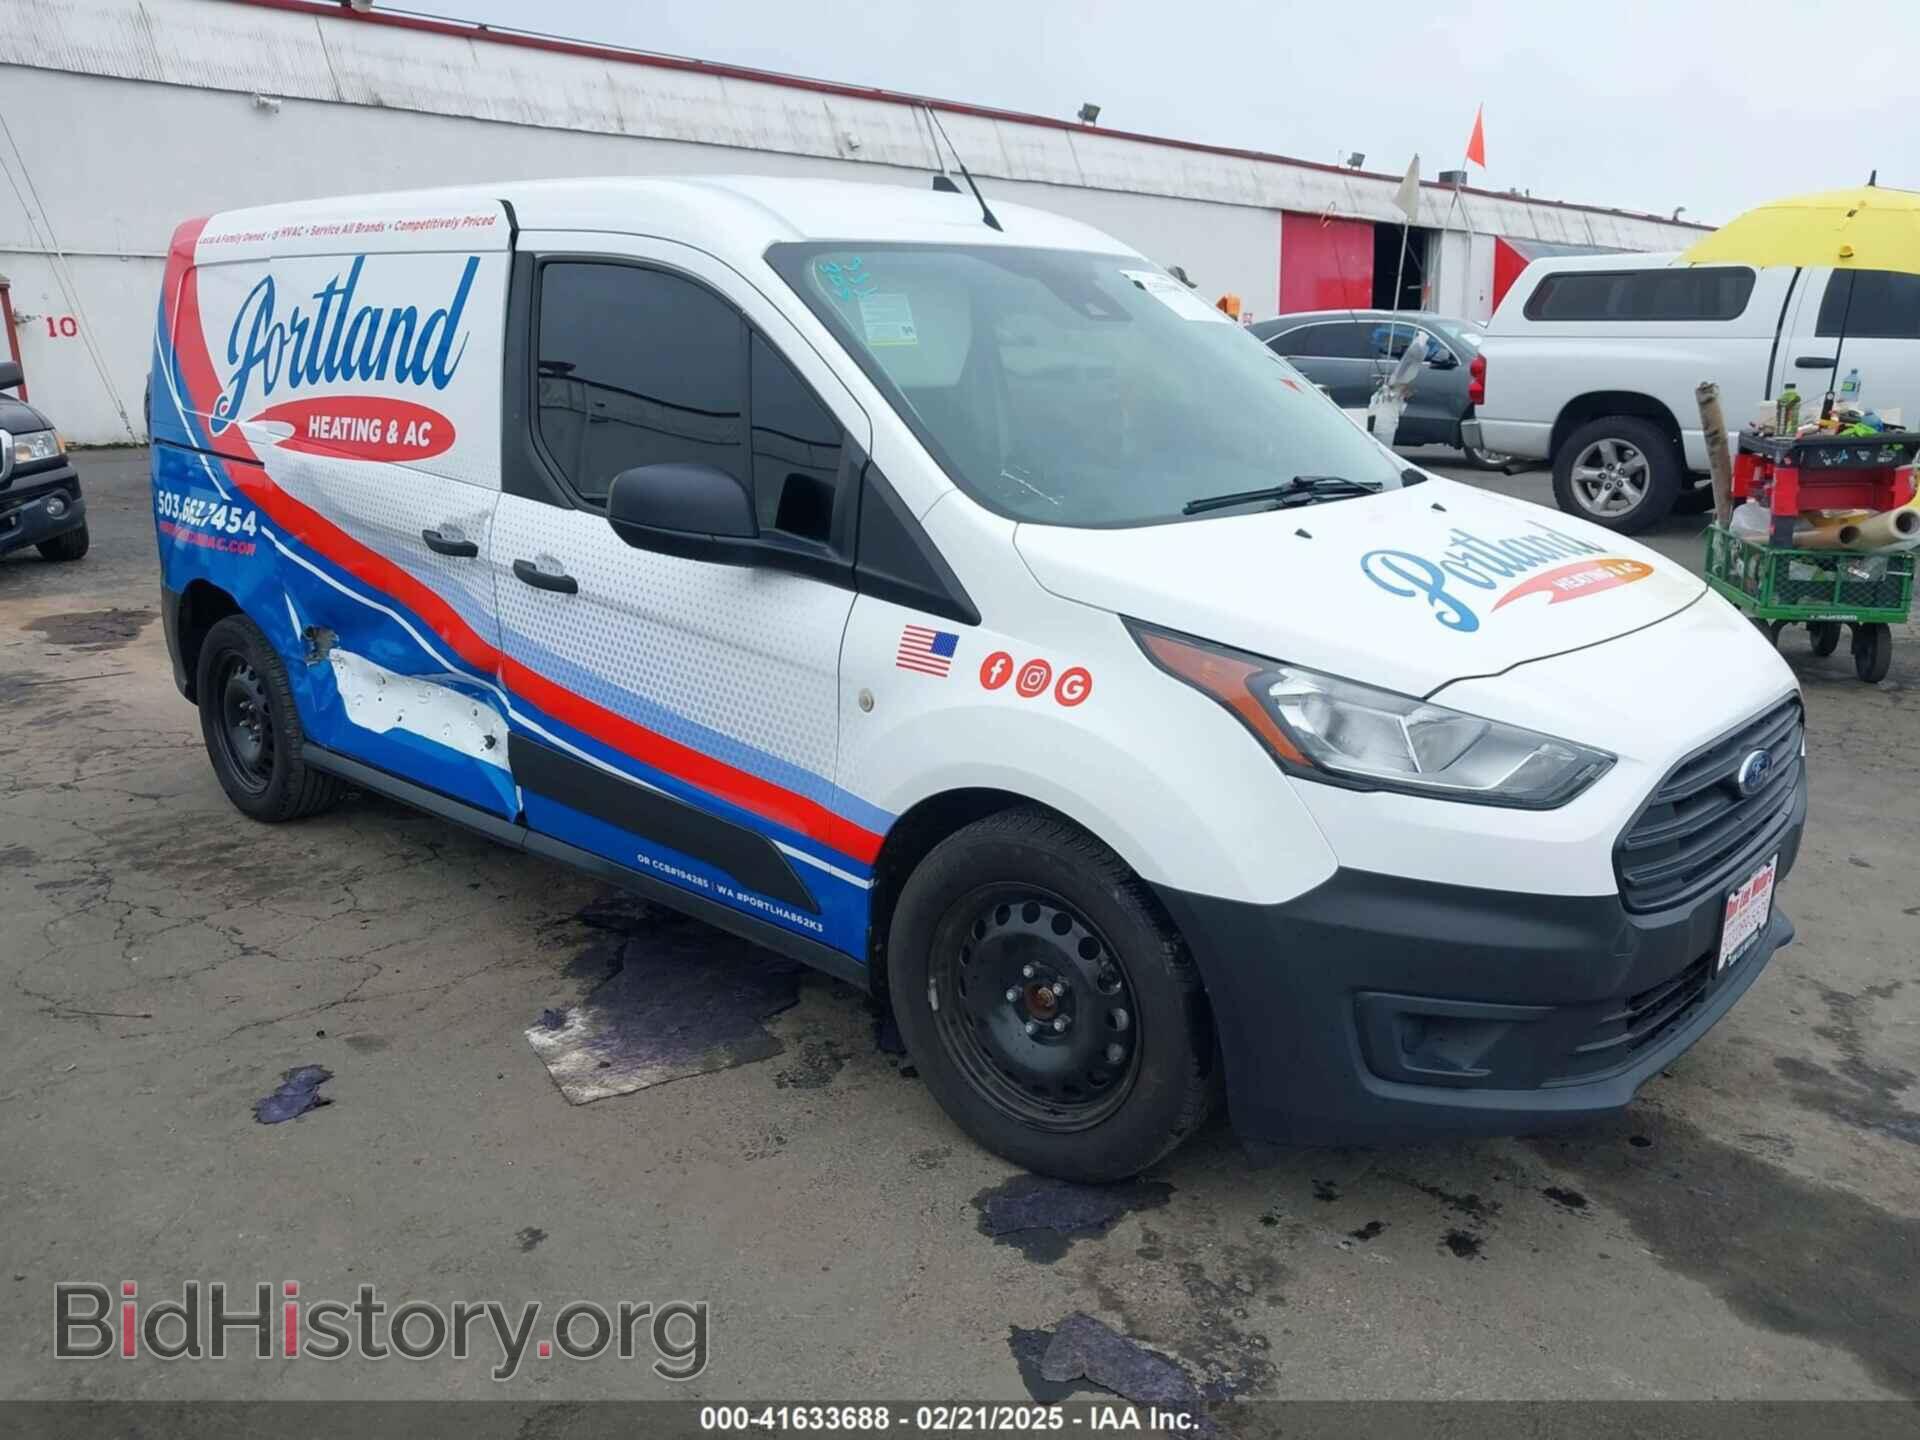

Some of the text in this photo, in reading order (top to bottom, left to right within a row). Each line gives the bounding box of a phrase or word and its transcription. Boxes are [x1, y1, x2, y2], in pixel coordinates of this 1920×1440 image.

[310, 223, 340, 236] Service
[341, 222, 355, 234] All
[355, 221, 385, 234] Brands
[394, 217, 458, 233] Competitively
[462, 214, 497, 228] Priced
[47, 316, 77, 337] 10
[209, 255, 481, 435] Portland
[307, 414, 433, 448] HEATING & AC
[637, 854, 650, 865] OR
[716, 884, 735, 898] WA
